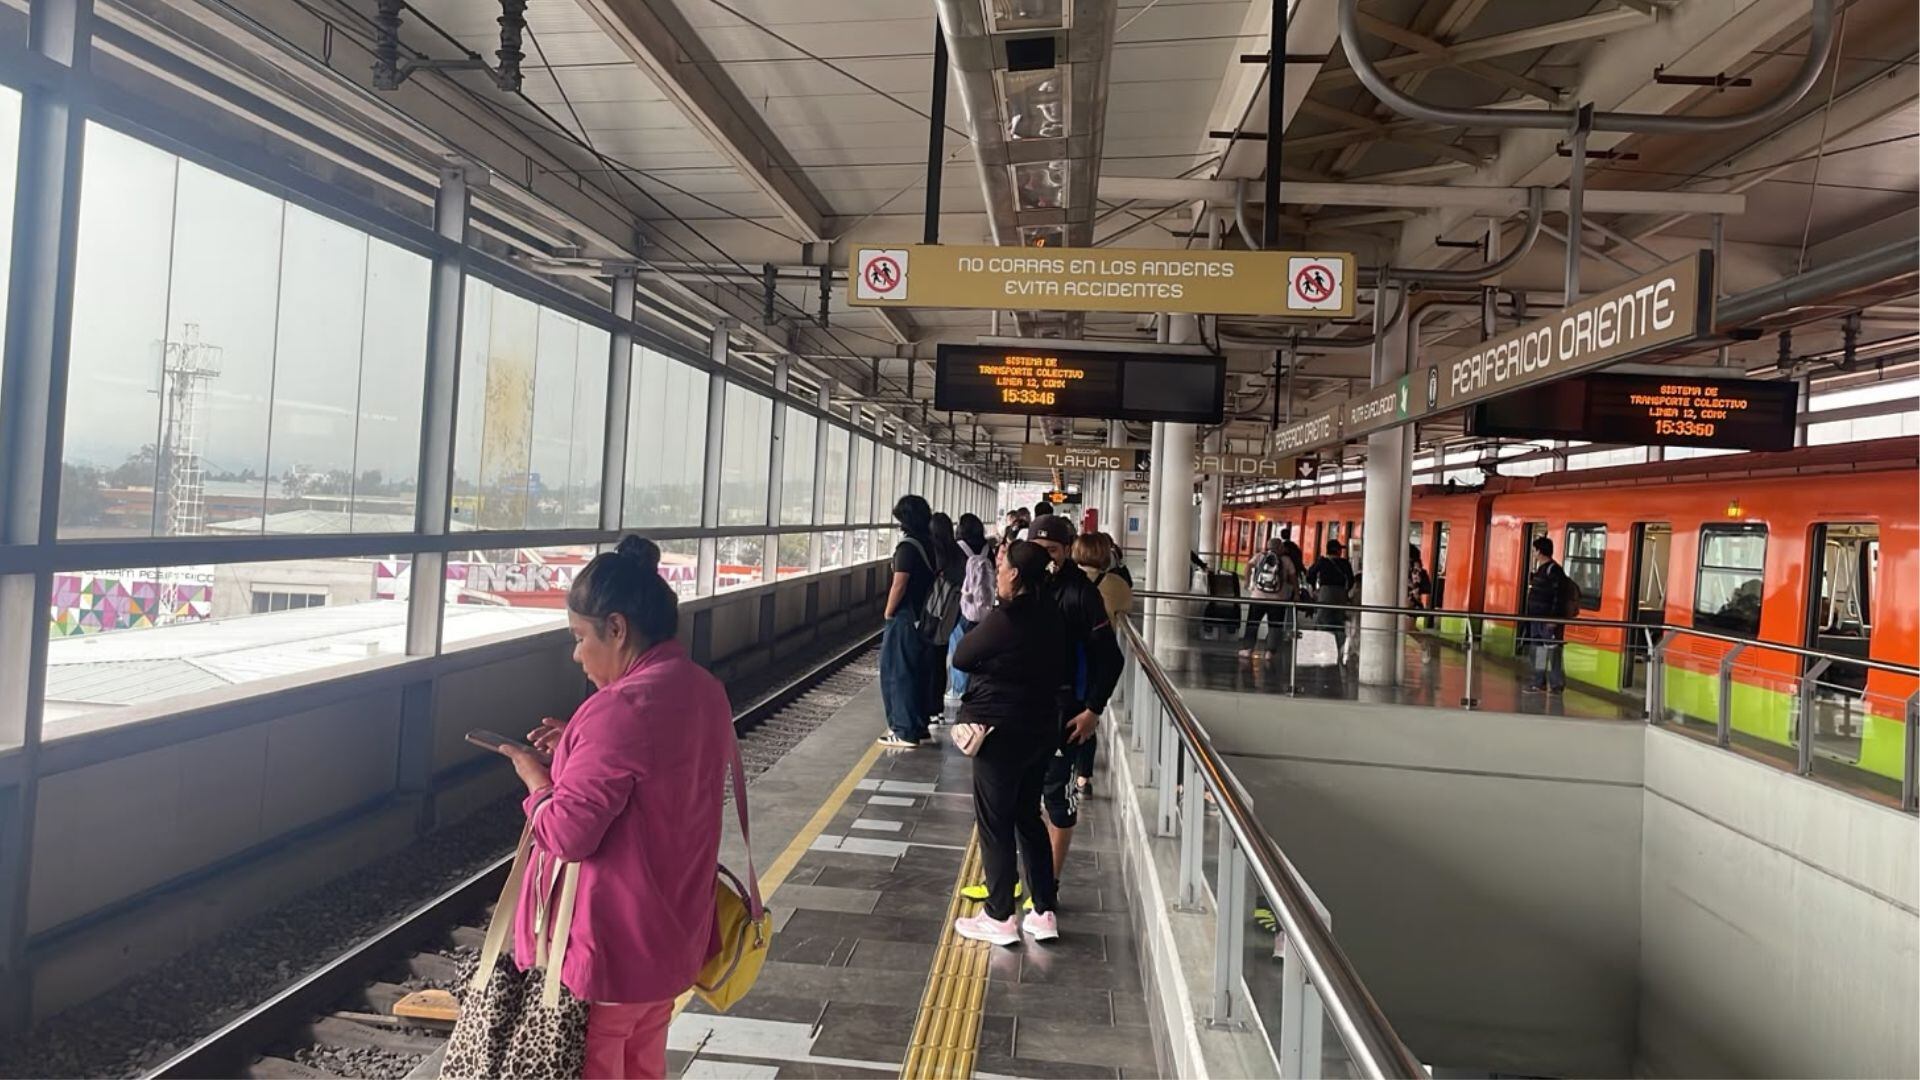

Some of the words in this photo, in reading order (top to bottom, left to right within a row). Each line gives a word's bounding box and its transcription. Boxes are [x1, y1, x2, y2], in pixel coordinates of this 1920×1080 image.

[958, 257, 984, 272] NO
[989, 258, 1065, 274] CORRAS
[1069, 259, 1095, 274] EN
[1101, 260, 1137, 275] LOS
[1142, 261, 1235, 278] ANDENES
[1004, 280, 1059, 295] EVITA
[1064, 281, 1184, 298] ACCIDENTES
[1451, 326, 1553, 398] PERIFERICO
[1558, 277, 1676, 362] ORIENTE
[1005, 356, 1042, 366] SISTEMA
[1045, 358, 1058, 367] DE
[979, 365, 1033, 376] TRANSPORTE
[1036, 368, 1084, 379] COLECTIVO
[996, 377, 1023, 386] LINEA
[1027, 378, 1040, 389] 12,
[1002, 388, 1055, 405] 15:33:46
[1660, 385, 1701, 396] SISTEMA
[1704, 387, 1719, 397] DE
[1630, 395, 1690, 406] TRANSPORTE
[1694, 398, 1748, 410] COLECTIVO
[1649, 407, 1679, 417] LINEA
[1683, 409, 1697, 420] 12,
[1655, 420, 1715, 437] 15:33:50
[1045, 454, 1121, 469] TLAHUAC
